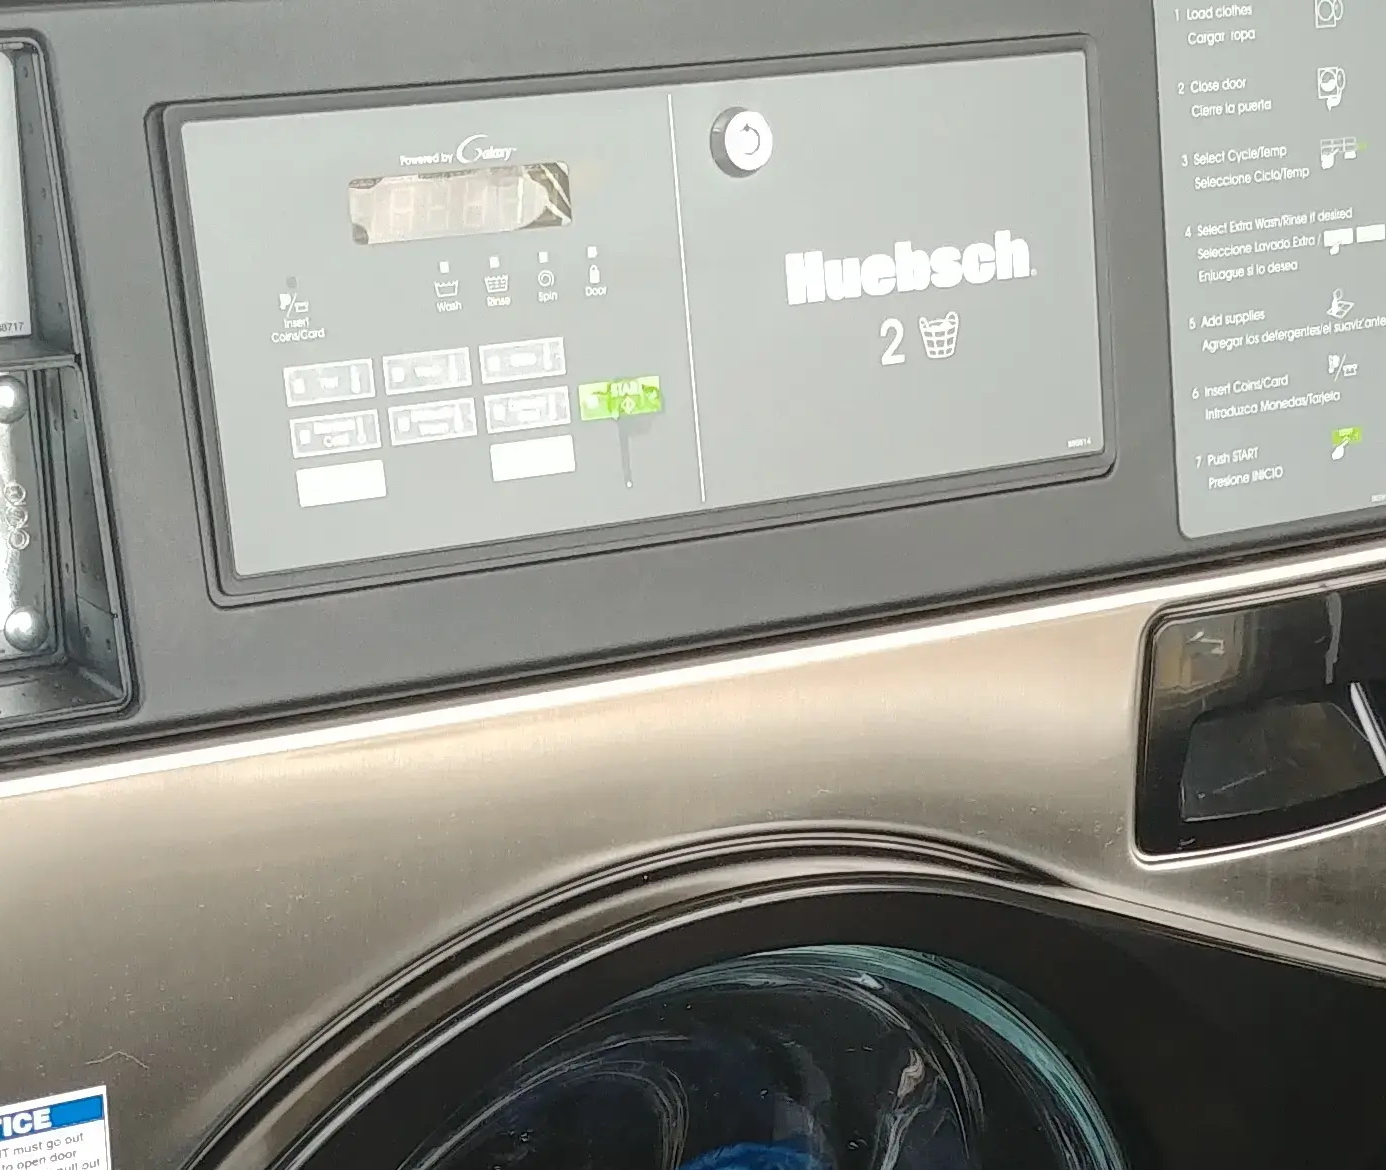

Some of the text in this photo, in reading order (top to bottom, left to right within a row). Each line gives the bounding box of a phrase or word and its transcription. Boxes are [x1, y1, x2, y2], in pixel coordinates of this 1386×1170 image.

[1174, 4, 1253, 22] 1 Load clothes
[1187, 29, 1256, 47] Cargar ropa
[1177, 77, 1247, 95] 2 Close door
[1191, 98, 1272, 118] Cierre la puerta
[1181, 145, 1287, 167] 3 Select Cycle/Temp
[1194, 167, 1310, 190] Seleccione Ciclo/Temp
[1184, 206, 1353, 238] 4 Select Extra Wash/Rinse if desired
[1197, 233, 1322, 260] Seleccione Lavado Extra /
[784, 229, 1030, 306] Huebsch
[1198, 261, 1298, 283] Enjuague si lo desea
[538, 291, 558, 303] Spin
[584, 285, 607, 297] Door
[283, 316, 310, 329] Insert
[1189, 309, 1266, 330] 5 Add supplies
[270, 327, 326, 343] Coins/Card
[880, 318, 906, 366] 2
[1191, 373, 1289, 400] 6 Insert Coins/Card
[1205, 390, 1341, 421] Introduzca Monedas/Tarjeta
[1195, 446, 1259, 469] 7 Push START
[1208, 465, 1284, 489] Presione INICIO
[13, 1141, 43, 1156] must
[46, 1138, 62, 1151] go
[64, 1132, 84, 1145] out
[16, 1156, 47, 1170] open
[49, 1150, 77, 1163] door
[81, 1158, 100, 1170] out
